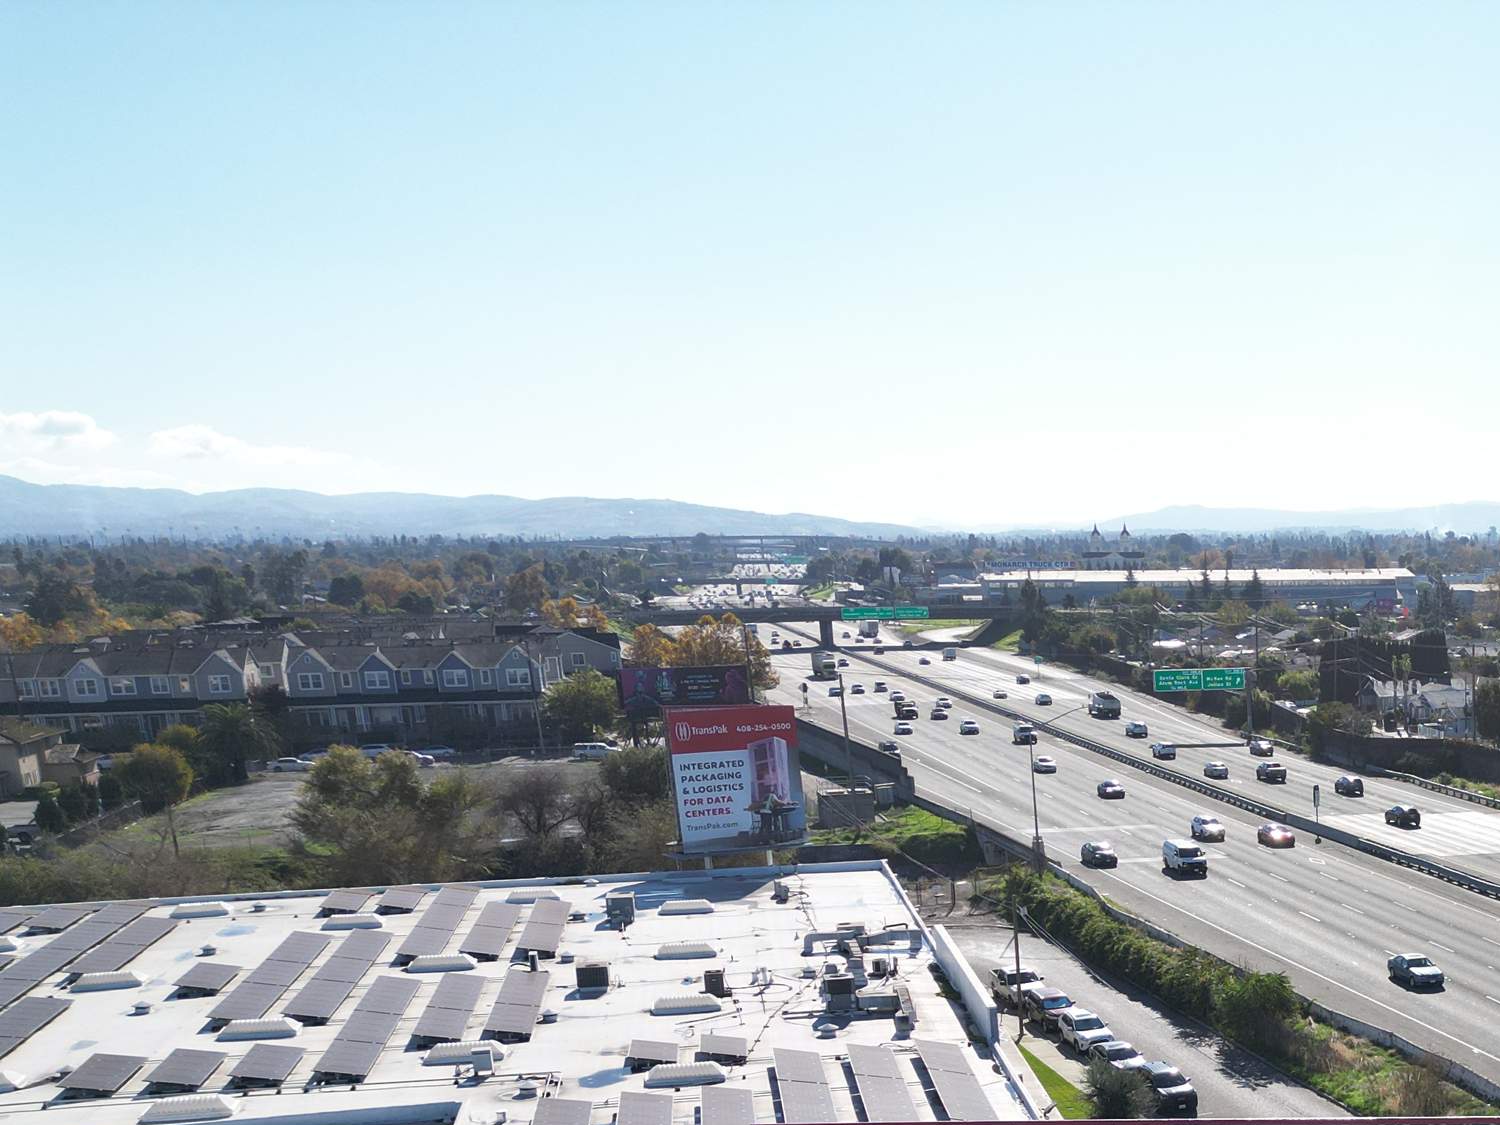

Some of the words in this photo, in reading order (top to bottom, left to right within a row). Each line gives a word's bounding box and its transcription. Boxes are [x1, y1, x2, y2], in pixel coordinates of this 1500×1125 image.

[991, 561, 1025, 569] MONARCH
[1029, 561, 1053, 569] TRUCK
[691, 725, 728, 736] TransPak
[736, 722, 791, 732] 408-254-0500
[680, 760, 744, 771] INTEGRATED
[681, 771, 742, 783] PACKAGING
[682, 786, 690, 795] &
[693, 783, 744, 793] LOGISTICS
[683, 797, 704, 806] FOR
[707, 795, 733, 804] DATA
[687, 822, 738, 832] TransPak.com
